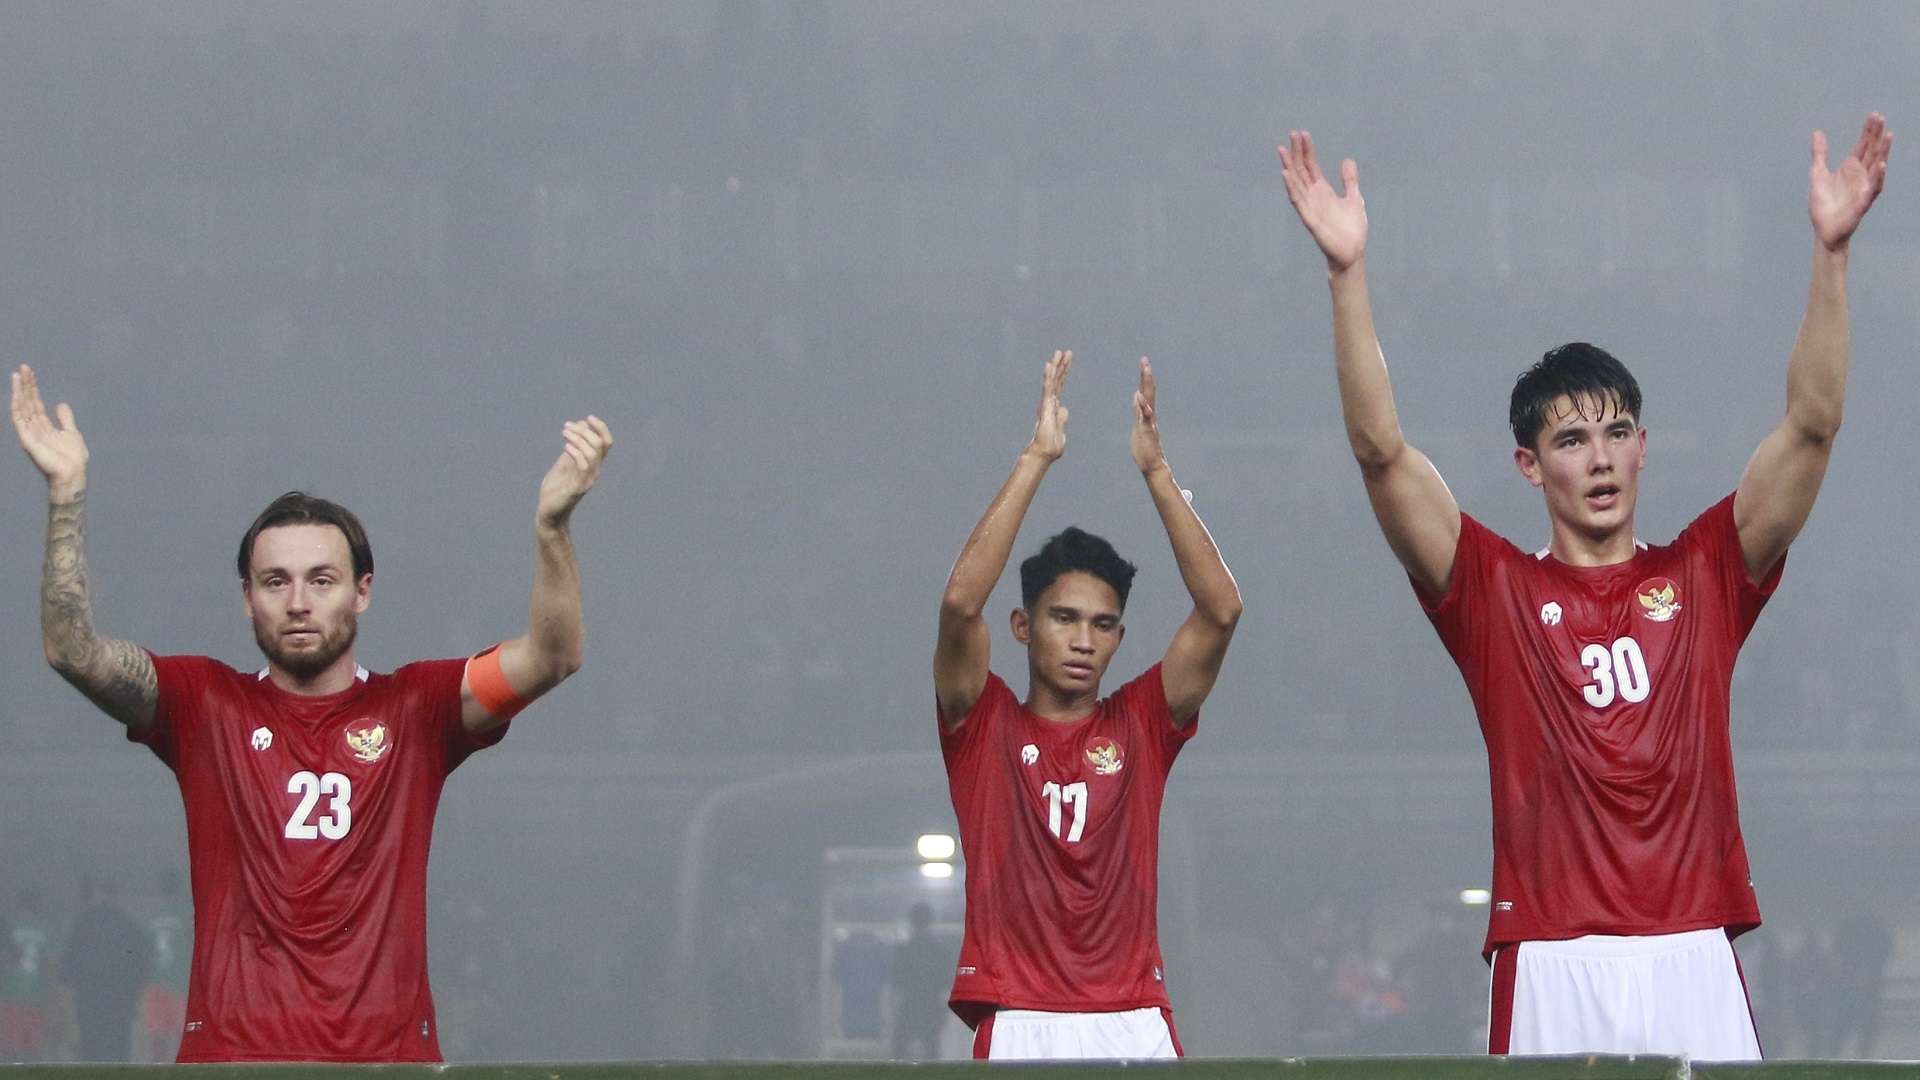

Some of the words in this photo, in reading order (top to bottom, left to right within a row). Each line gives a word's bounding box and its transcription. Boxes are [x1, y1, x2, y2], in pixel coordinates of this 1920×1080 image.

[1581, 636, 1650, 708] 30
[284, 771, 352, 840] 23
[1042, 781, 1088, 842] 17
